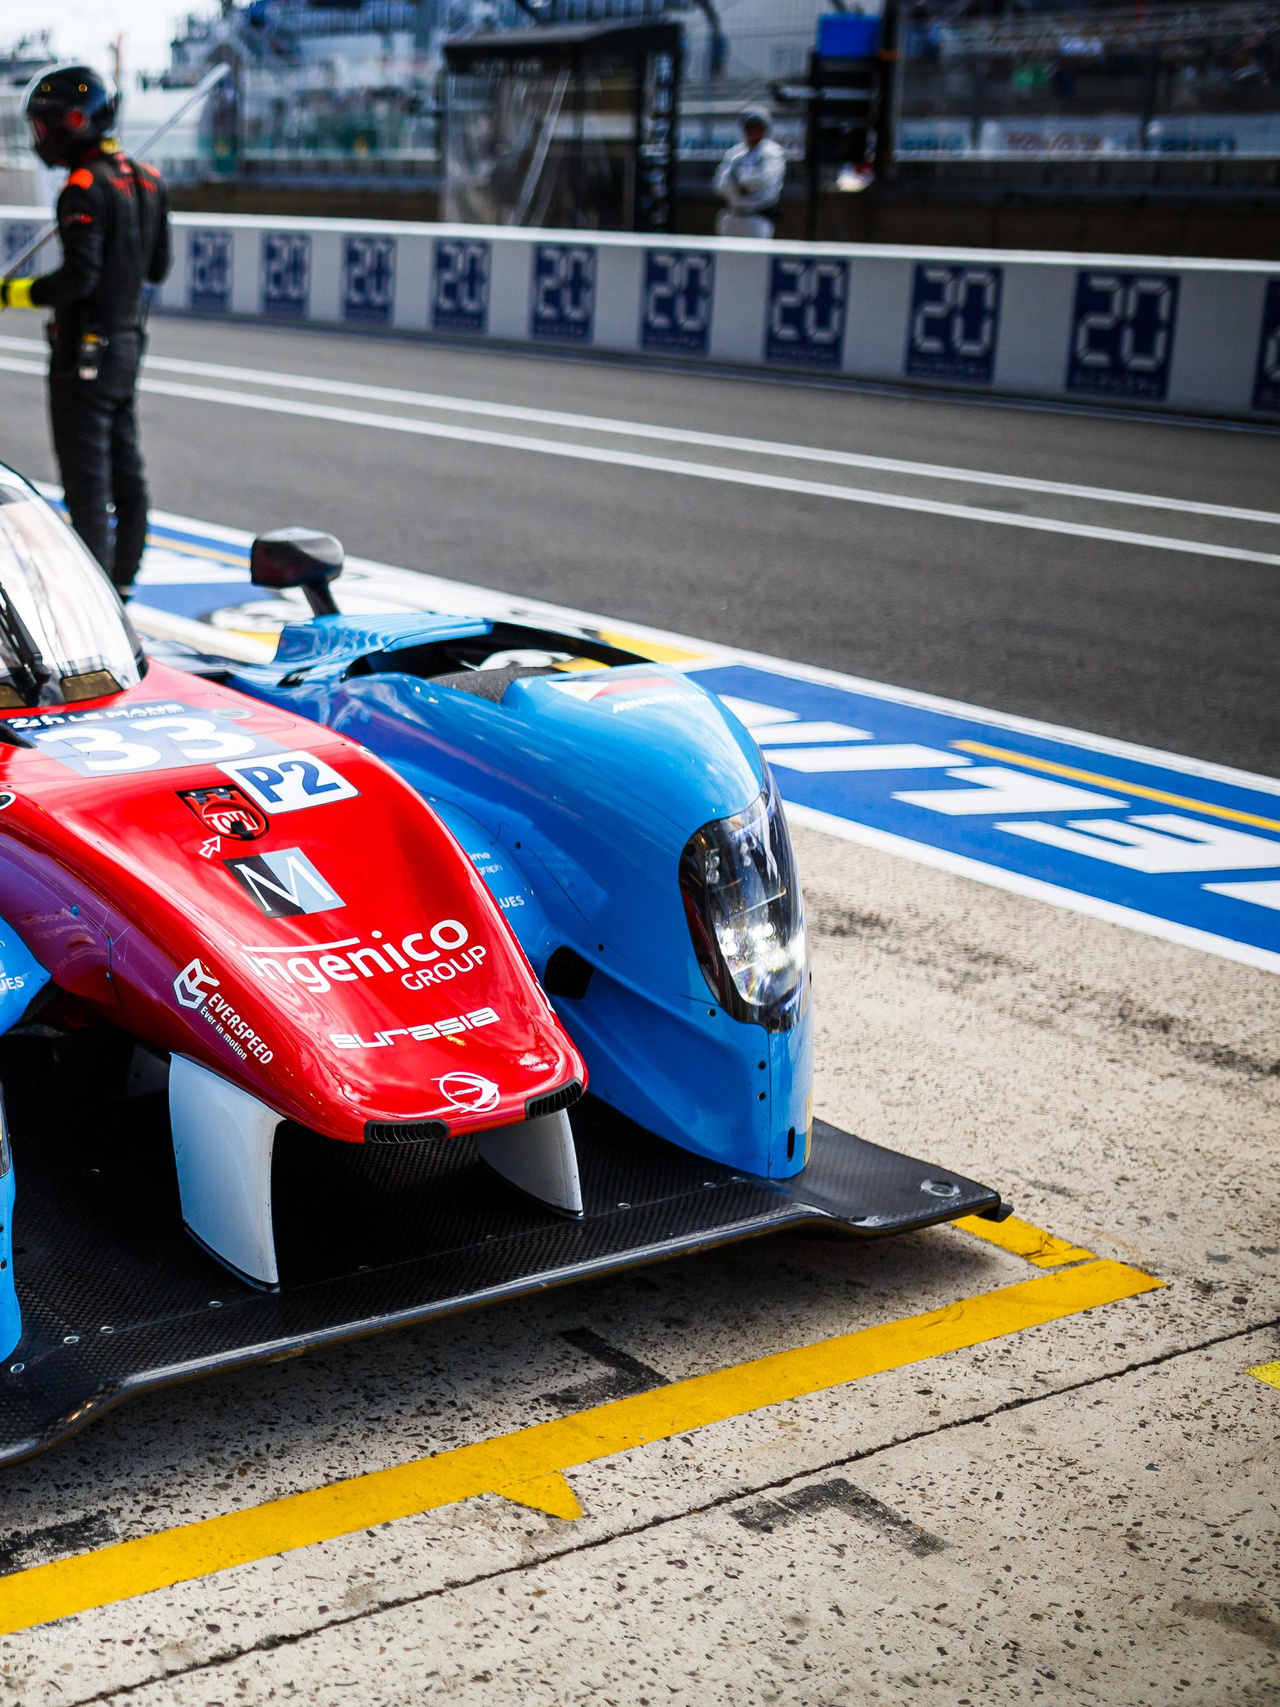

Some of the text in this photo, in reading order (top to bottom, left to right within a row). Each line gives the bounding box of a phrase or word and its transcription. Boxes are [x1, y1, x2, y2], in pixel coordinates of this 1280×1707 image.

[348, 237, 394, 305] 20
[437, 243, 488, 312] 20
[537, 248, 594, 321] 20
[649, 254, 711, 331] 20
[772, 261, 845, 343] 20
[915, 269, 996, 356] 20
[1078, 276, 1172, 372] 20
[7, 703, 186, 729] 24h LE MANS
[34, 716, 256, 771] 33
[235, 760, 342, 803] P2
[204, 811, 259, 834] TOW
[235, 919, 469, 993] ingenico
[401, 945, 487, 991] GROUP
[200, 1005, 248, 1060] Ever in motion
[207, 993, 274, 1064] EVERSPEED
[328, 1006, 501, 1050] eurasia
